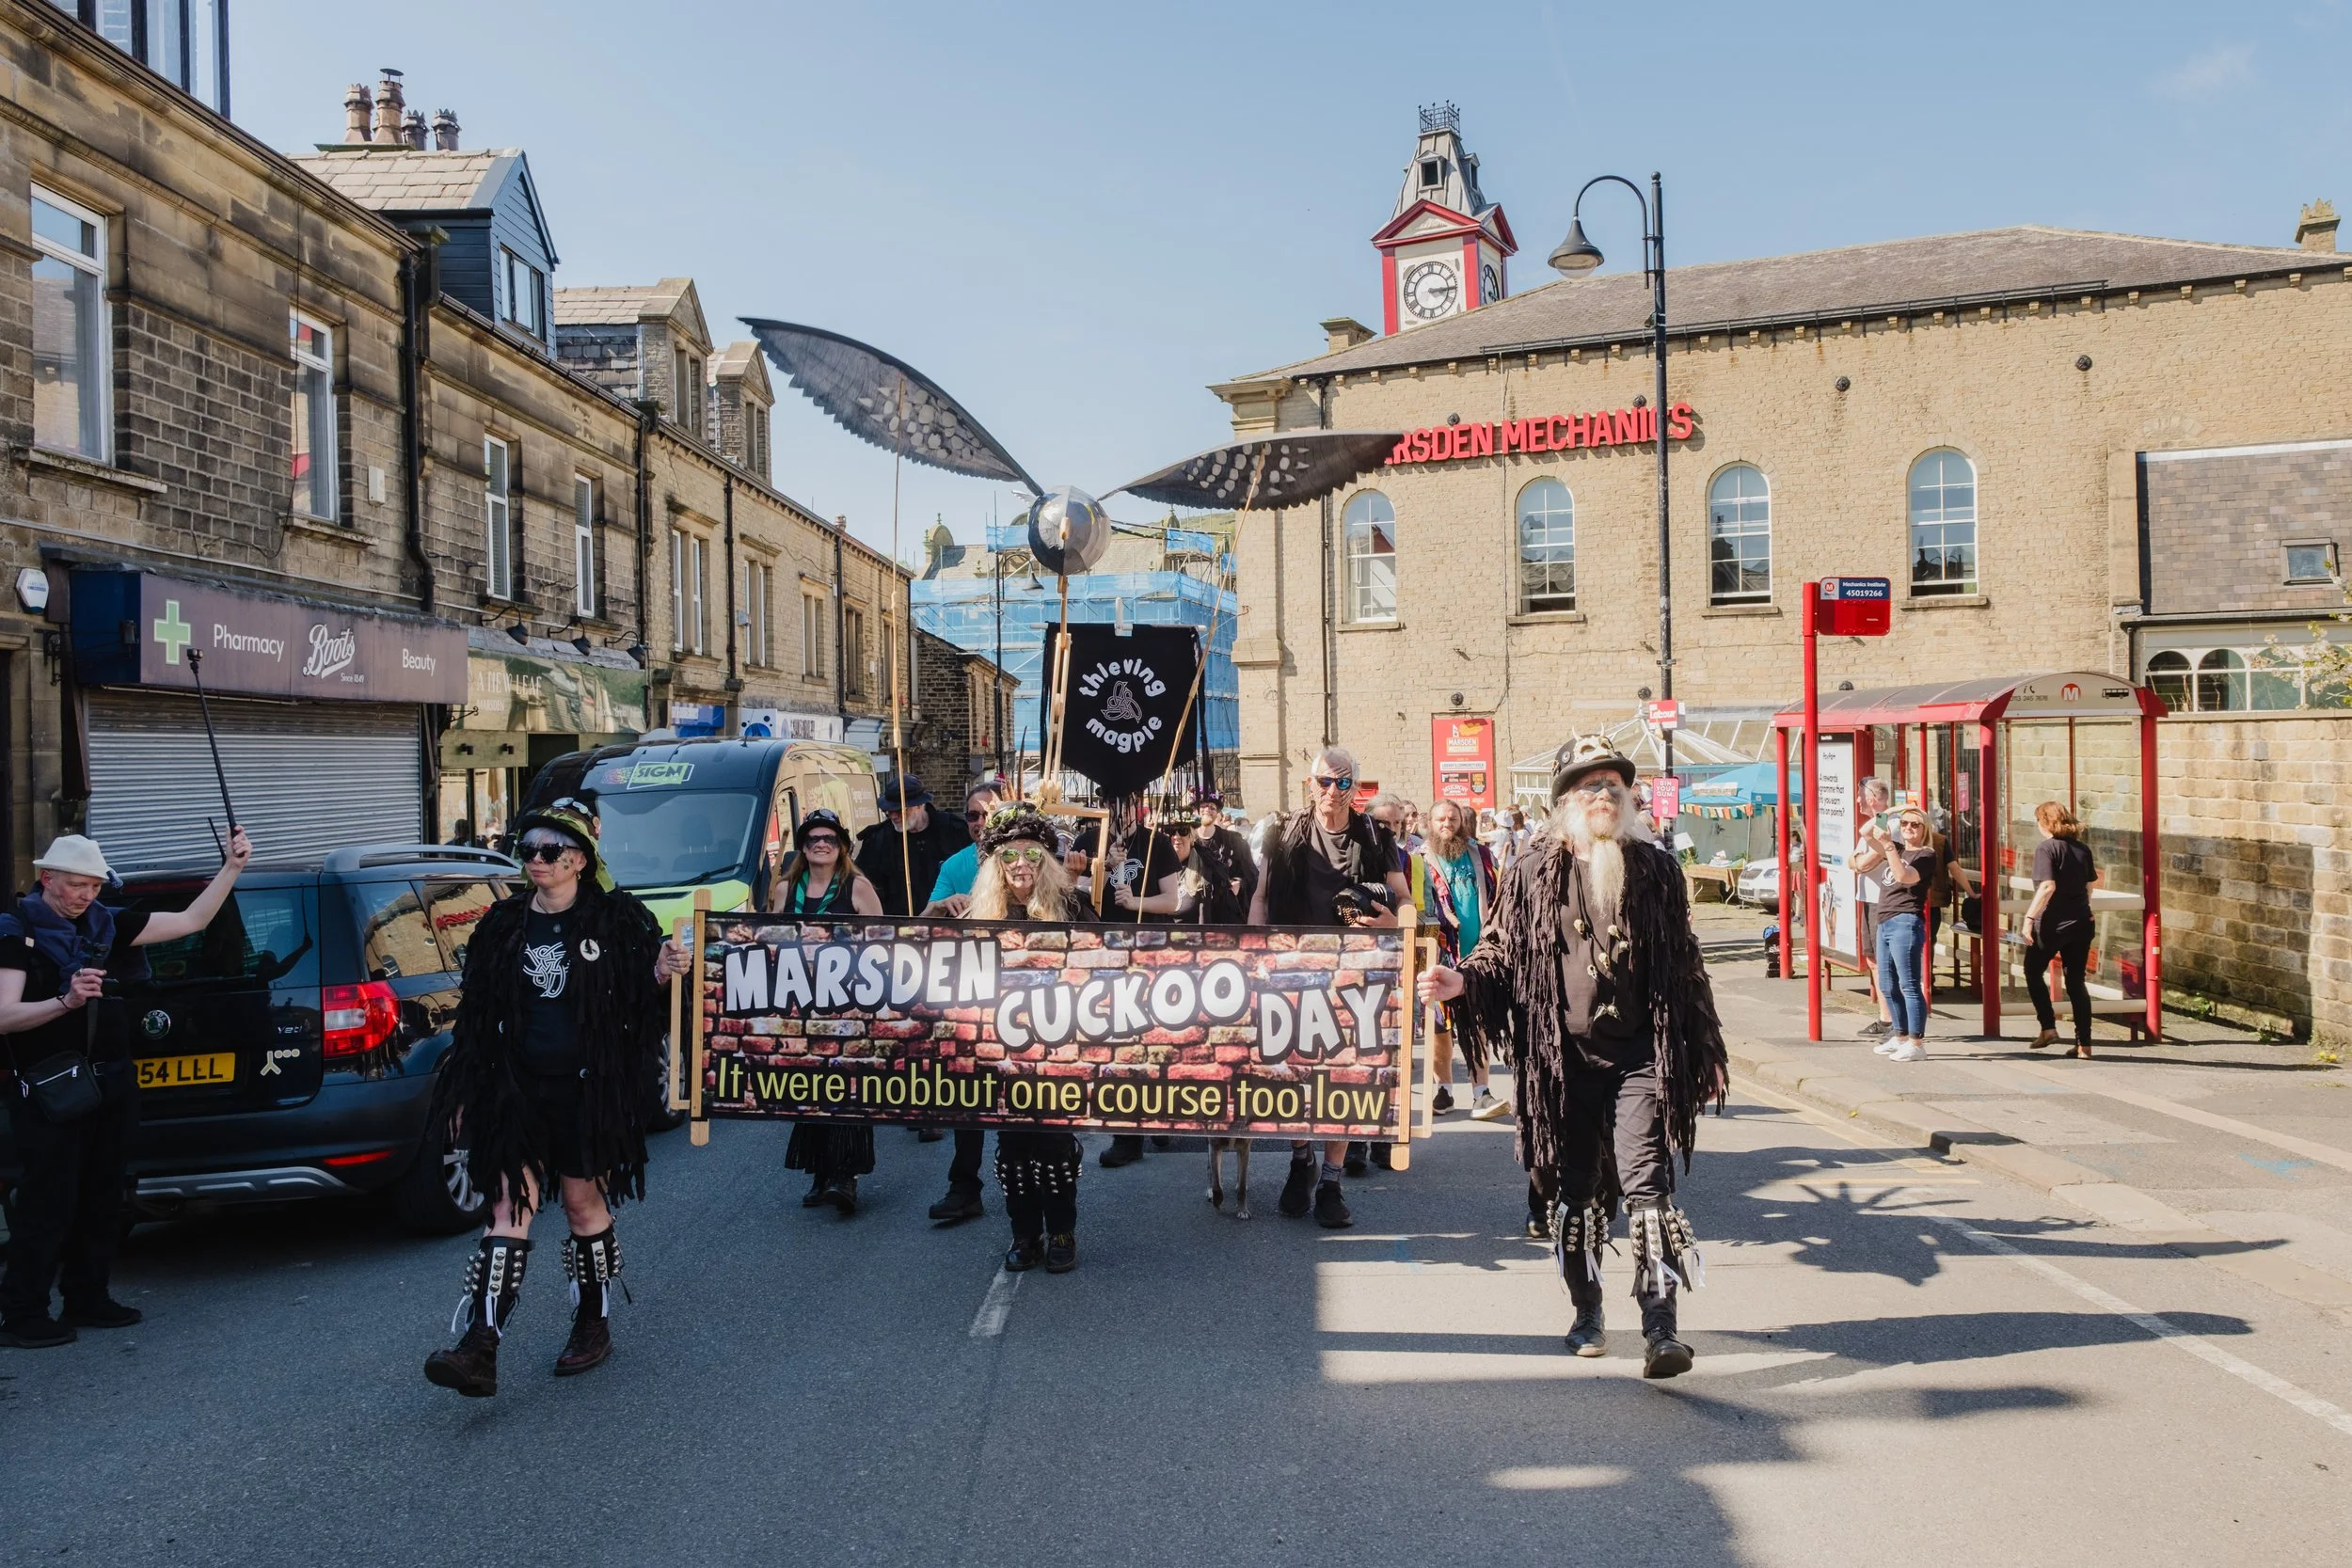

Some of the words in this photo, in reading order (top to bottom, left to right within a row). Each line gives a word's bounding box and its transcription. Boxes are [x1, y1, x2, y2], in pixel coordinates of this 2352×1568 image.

[1385, 421, 1494, 465] RSDEN
[214, 623, 285, 662] Pharmacy
[302, 624, 356, 679] Boots
[341, 673, 353, 683] Since
[354, 673, 364, 683] 1849
[402, 648, 436, 676] Beauty
[1078, 658, 1167, 698] thieving
[477, 672, 485, 692] A
[487, 672, 511, 693] NEW
[516, 673, 542, 696] LEAF
[476, 699, 505, 712] MARSDEN
[1649, 710, 1677, 719] Labour
[1085, 716, 1163, 753] magpie
[724, 940, 997, 1012] MARSDEN
[996, 961, 1247, 1048] CUCKOO
[1260, 984, 1386, 1057] DAY
[140, 1061, 169, 1085] 54
[177, 1057, 224, 1082] LLL
[719, 1057, 744, 1099] It
[756, 1070, 846, 1102] were
[862, 1062, 997, 1108] nobbut
[1010, 1078, 1082, 1112] one
[1098, 1082, 1222, 1116] course
[1236, 1079, 1299, 1118] too
[1316, 1074, 1386, 1120] low
